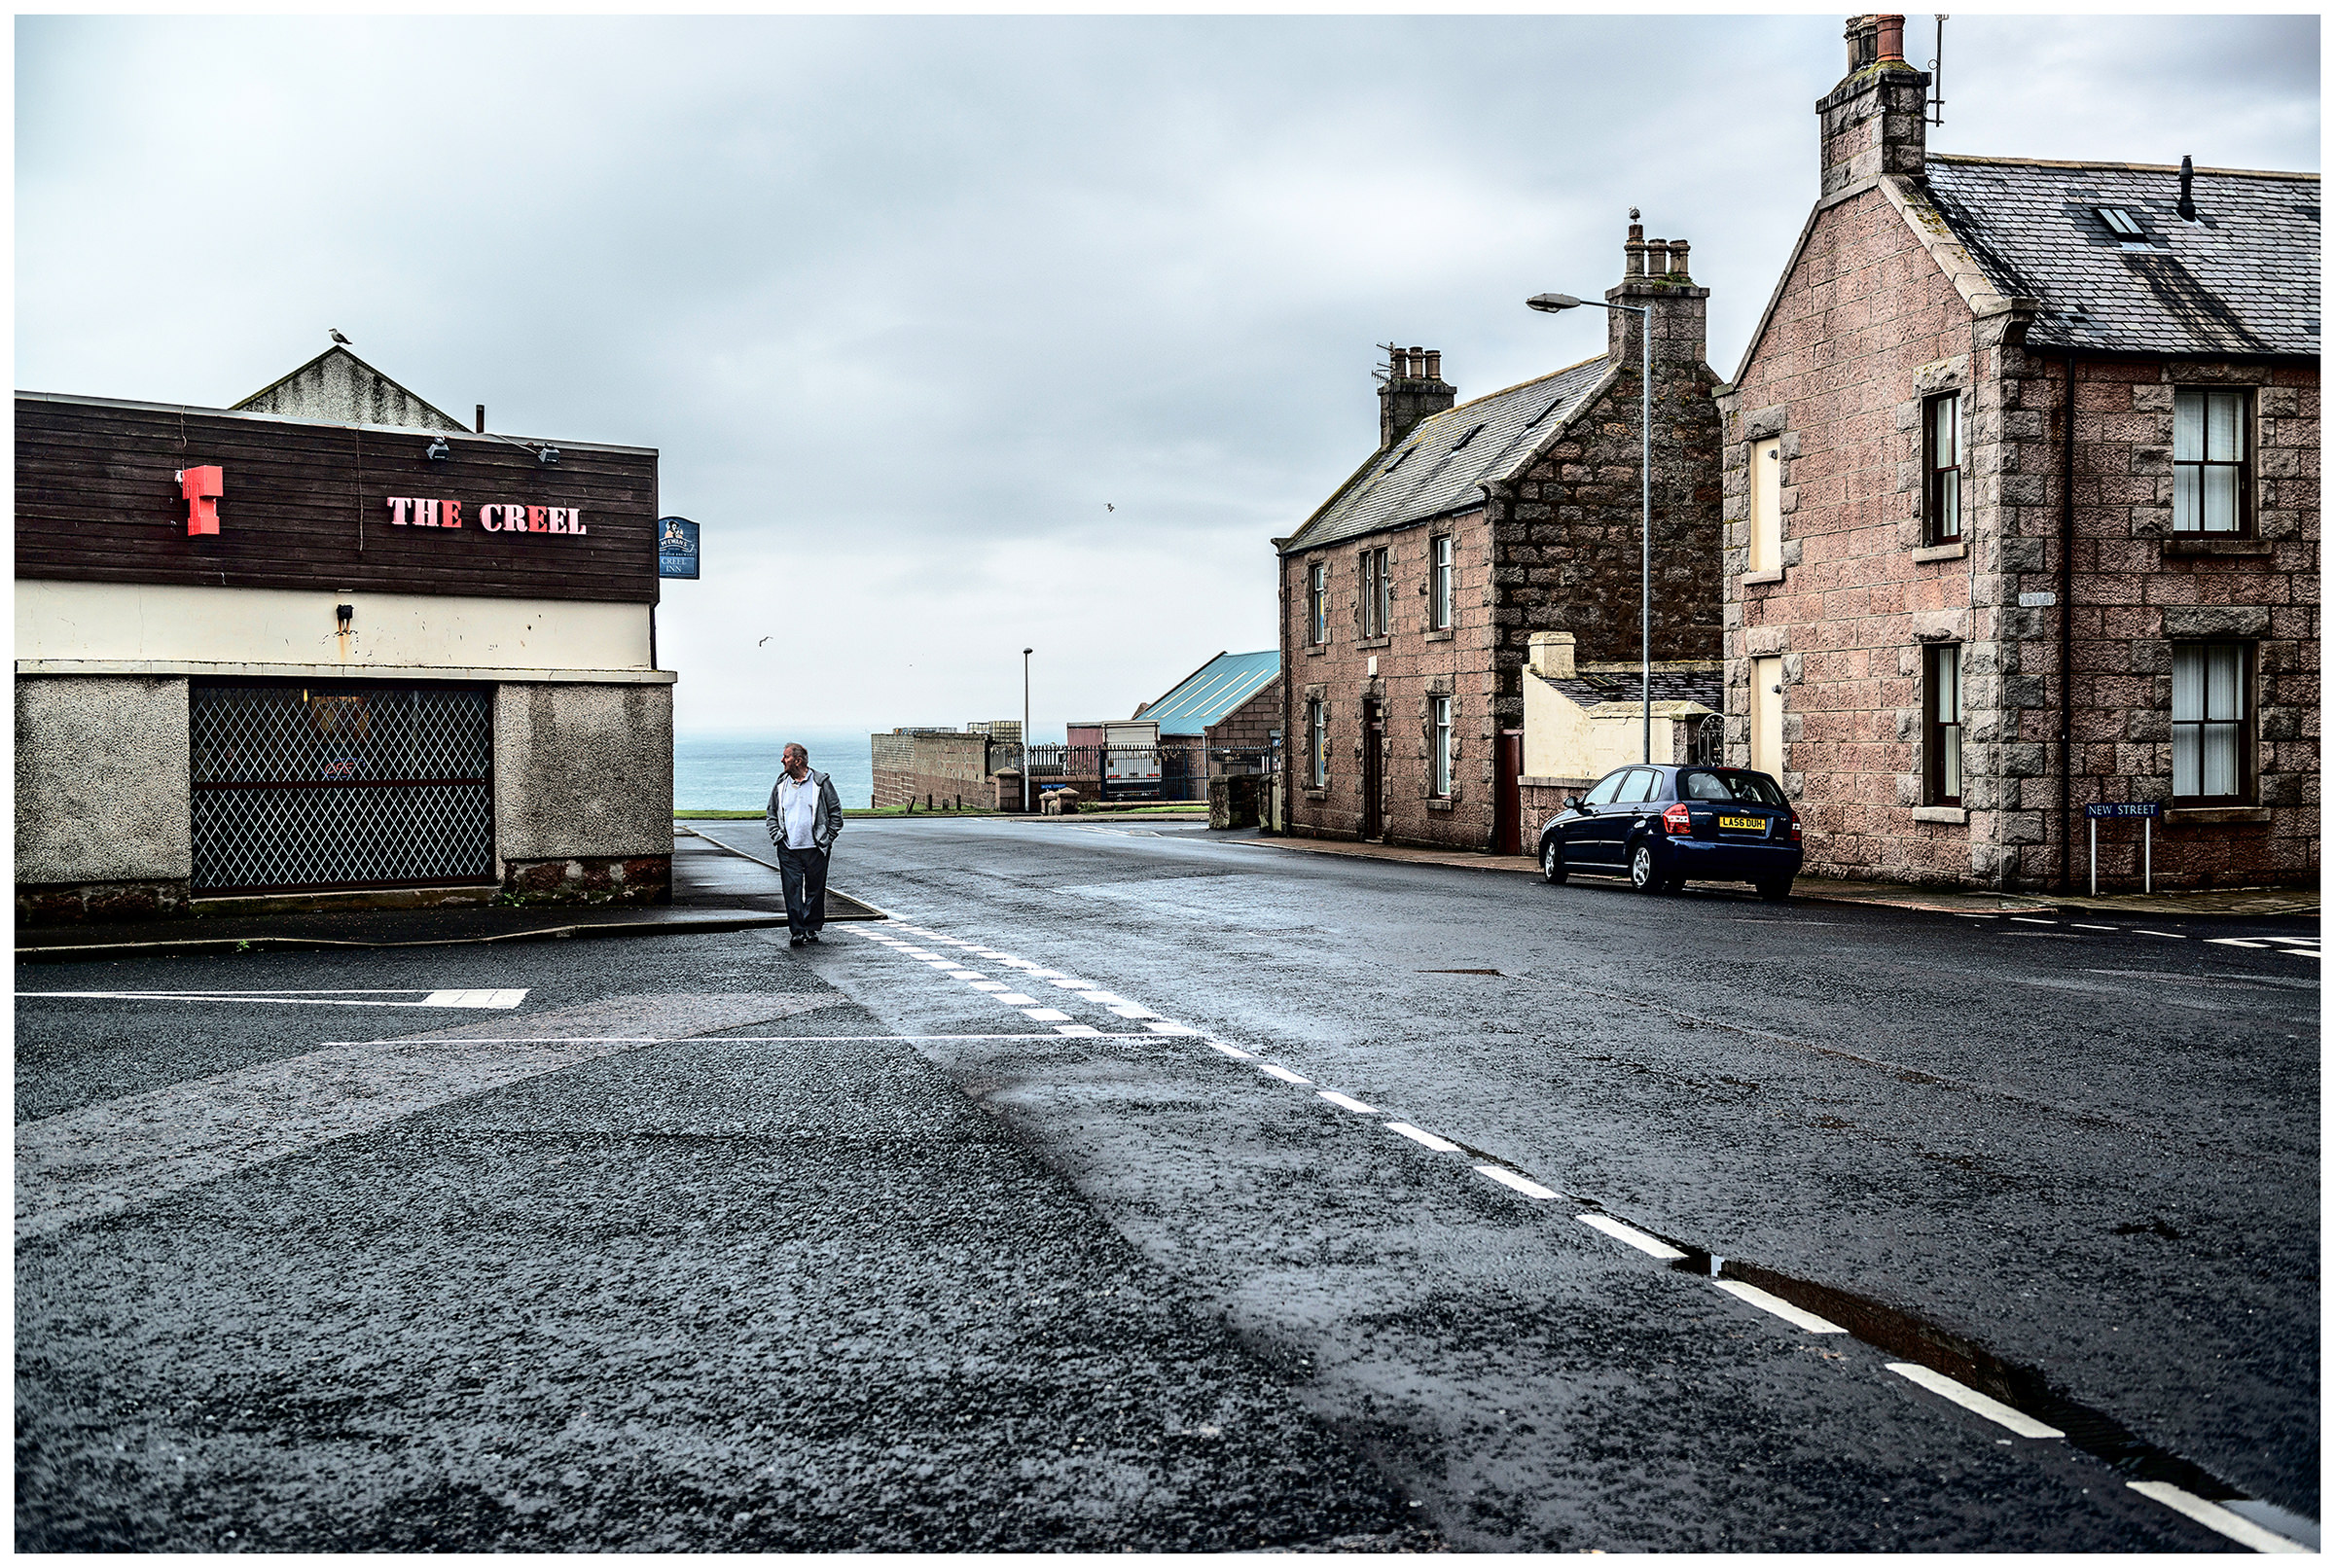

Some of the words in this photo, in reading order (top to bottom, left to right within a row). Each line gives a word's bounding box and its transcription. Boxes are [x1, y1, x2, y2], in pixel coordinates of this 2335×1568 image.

[387, 497, 462, 528] THE
[480, 504, 587, 535] CREEL
[2089, 805, 2112, 815] NEW
[2118, 804, 2155, 815] STREET
[1722, 817, 1744, 827] LA56
[1746, 818, 1762, 828] DUH
